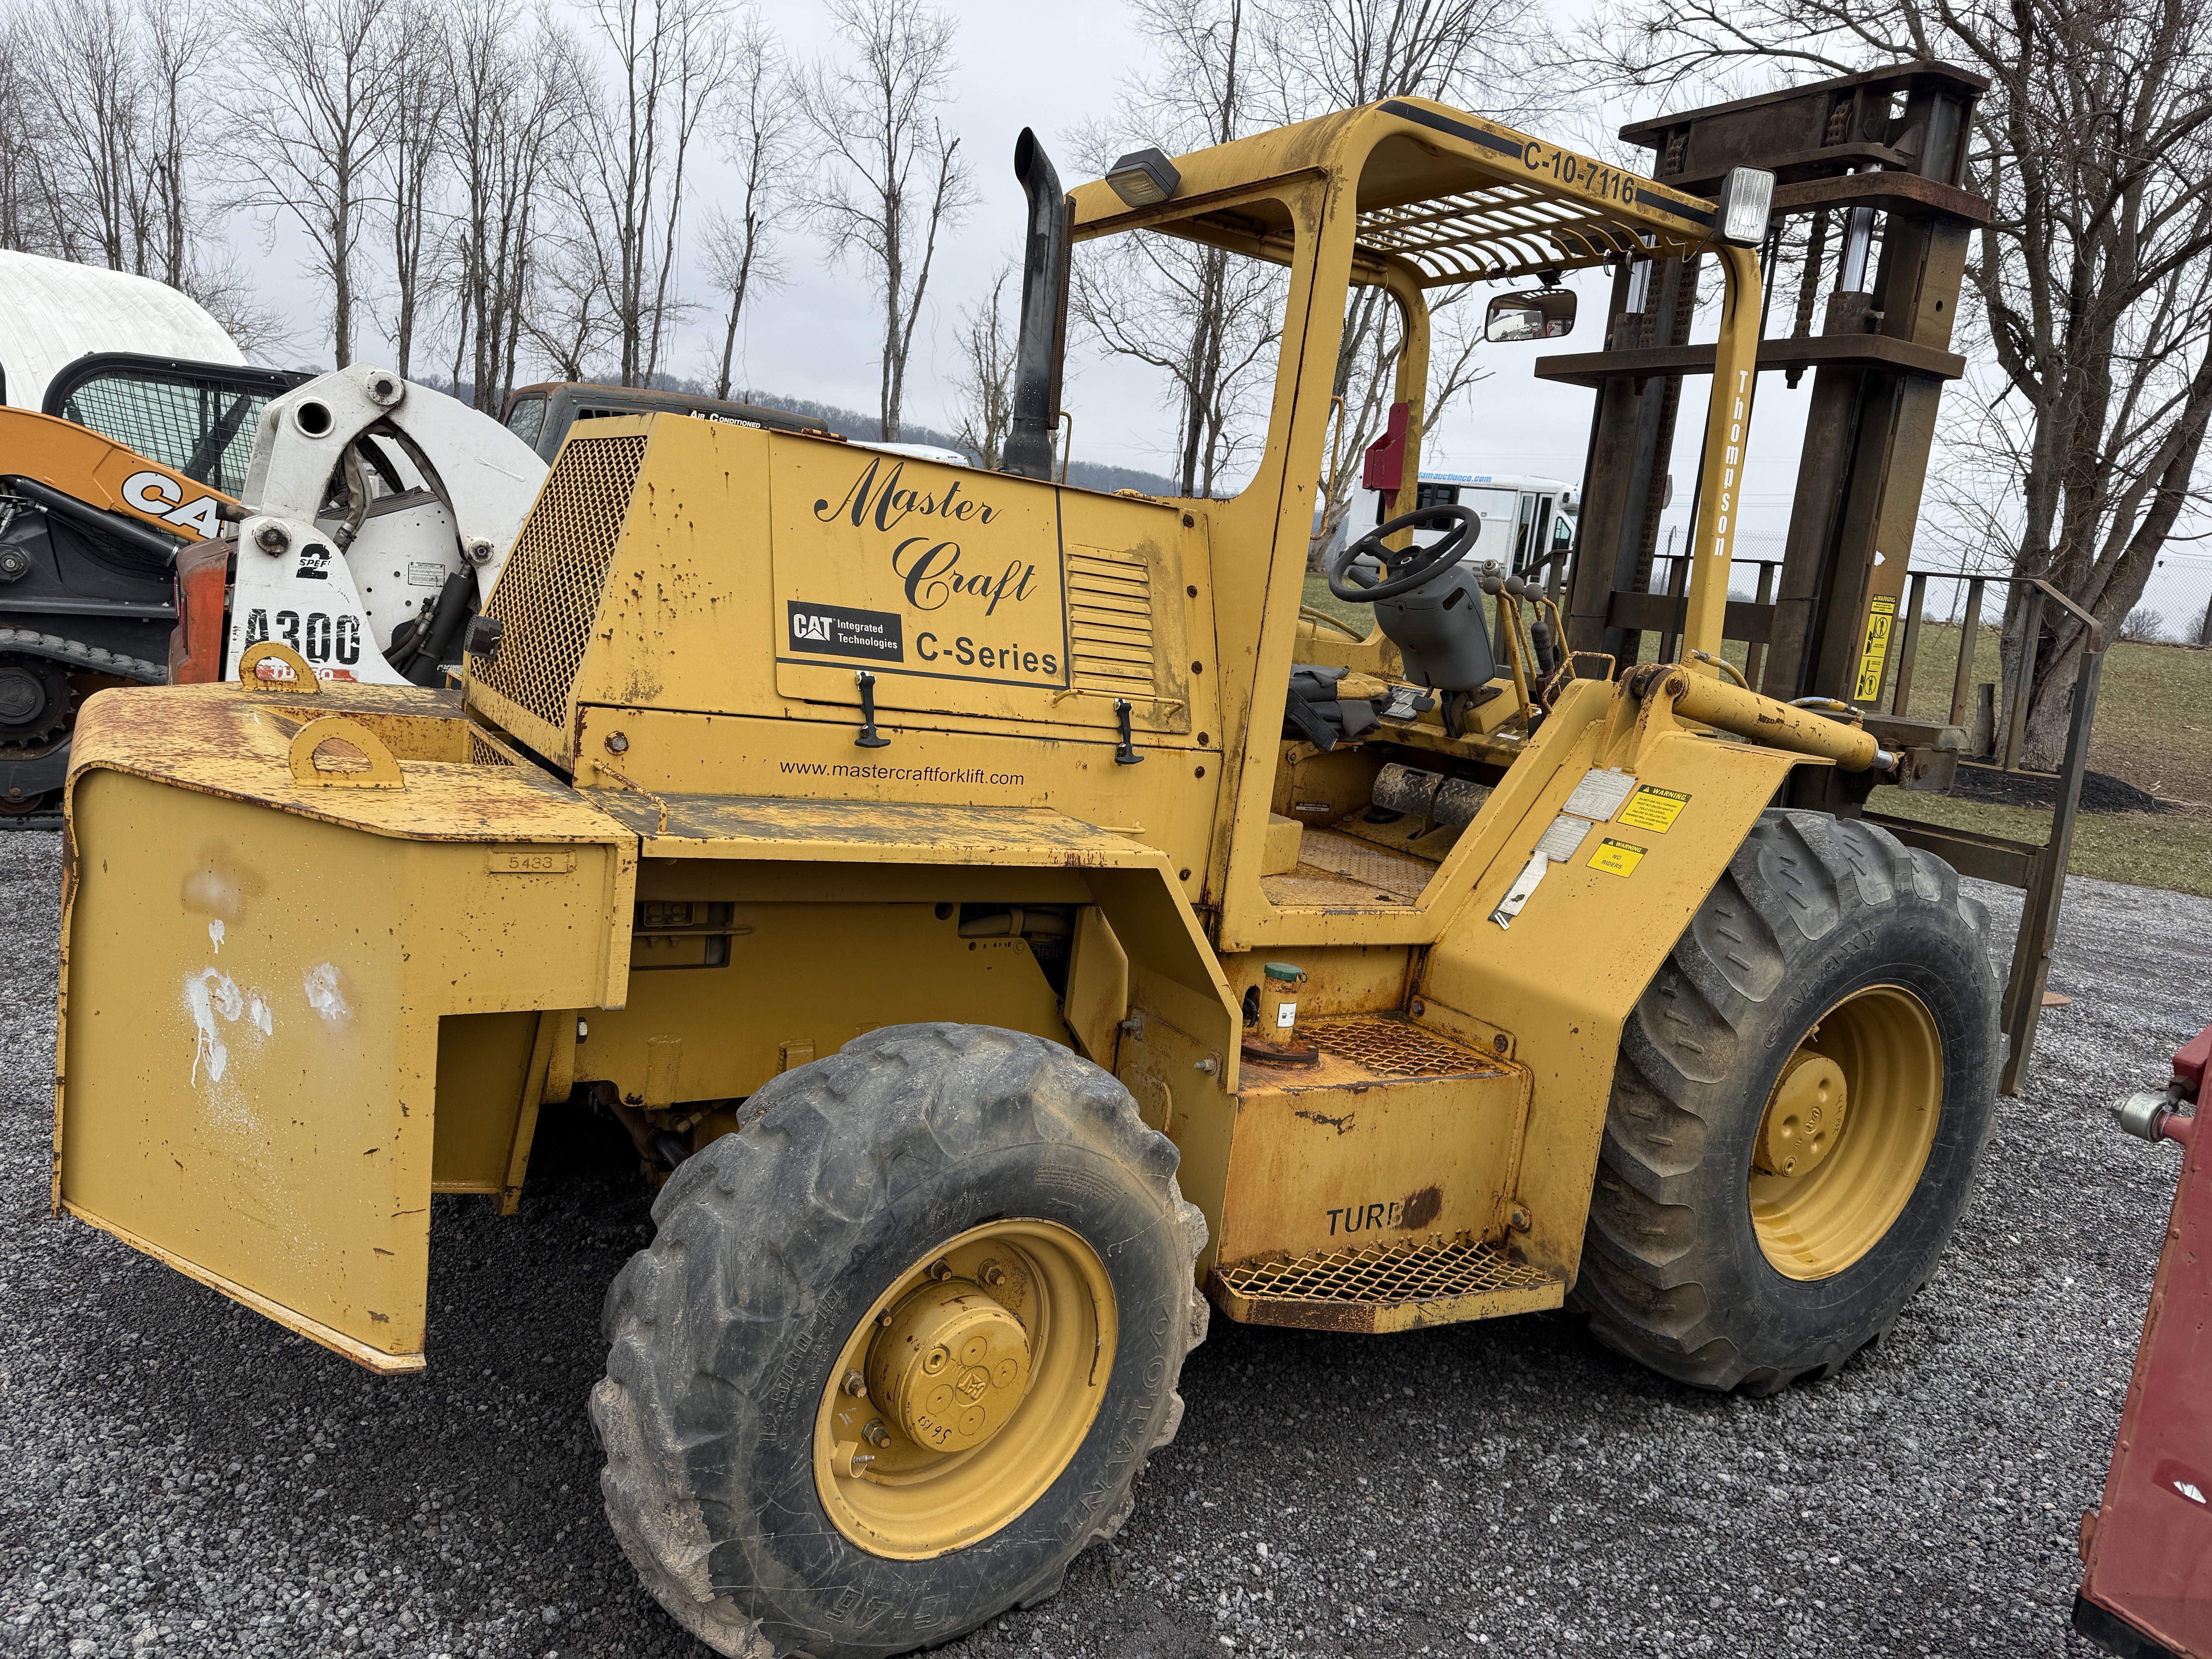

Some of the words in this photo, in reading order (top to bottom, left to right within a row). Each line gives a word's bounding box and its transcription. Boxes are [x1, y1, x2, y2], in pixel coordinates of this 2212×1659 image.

[1524, 142, 1636, 204] C-10-7116
[1715, 370, 1748, 556] Thompson
[814, 457, 1004, 532] Master
[892, 537, 1038, 617] Craft
[244, 608, 360, 665] A300
[793, 614, 832, 641] CAT
[837, 618, 883, 634] Integrated
[838, 633, 898, 650] Technologies
[917, 632, 1057, 675] C-Series
[779, 759, 1025, 786] www.mastercraftforklift.com
[1653, 788, 1687, 801] WARNING
[1616, 842, 1642, 852] WARNING
[509, 857, 552, 869] 5433
[1601, 860, 1623, 869] RIDERS
